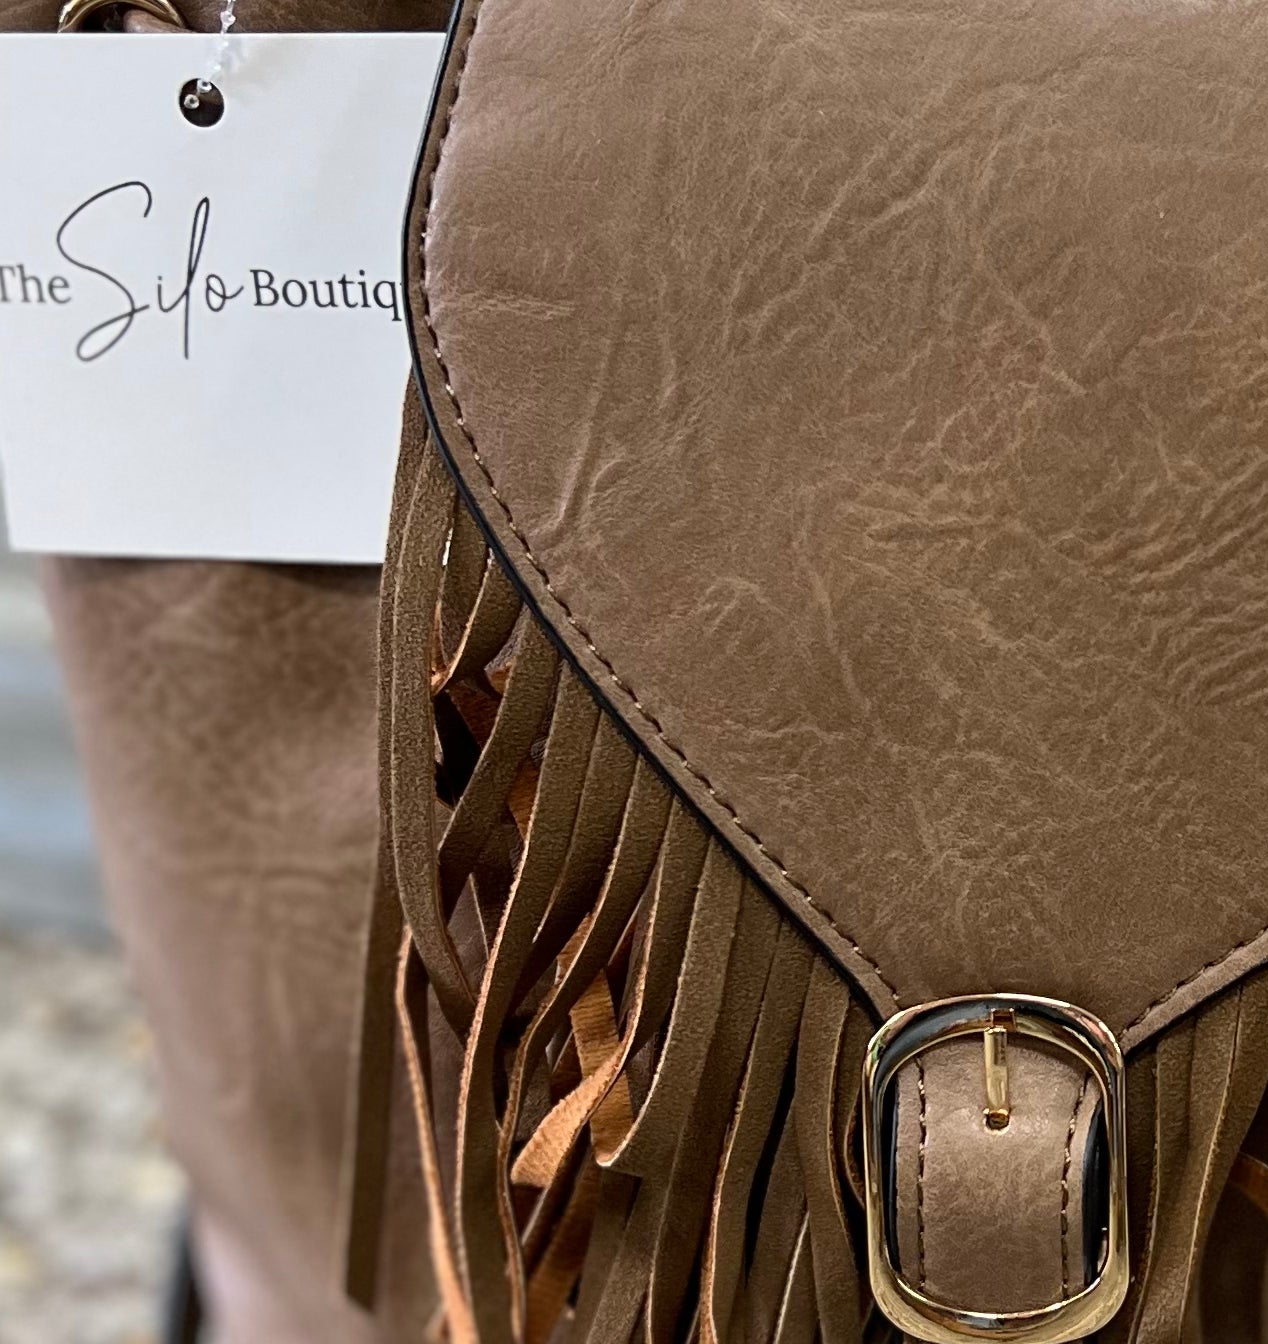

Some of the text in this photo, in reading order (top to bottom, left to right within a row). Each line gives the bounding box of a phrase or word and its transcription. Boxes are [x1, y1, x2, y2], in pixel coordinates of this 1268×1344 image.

[0, 180, 404, 362] The Silo Boutiq
